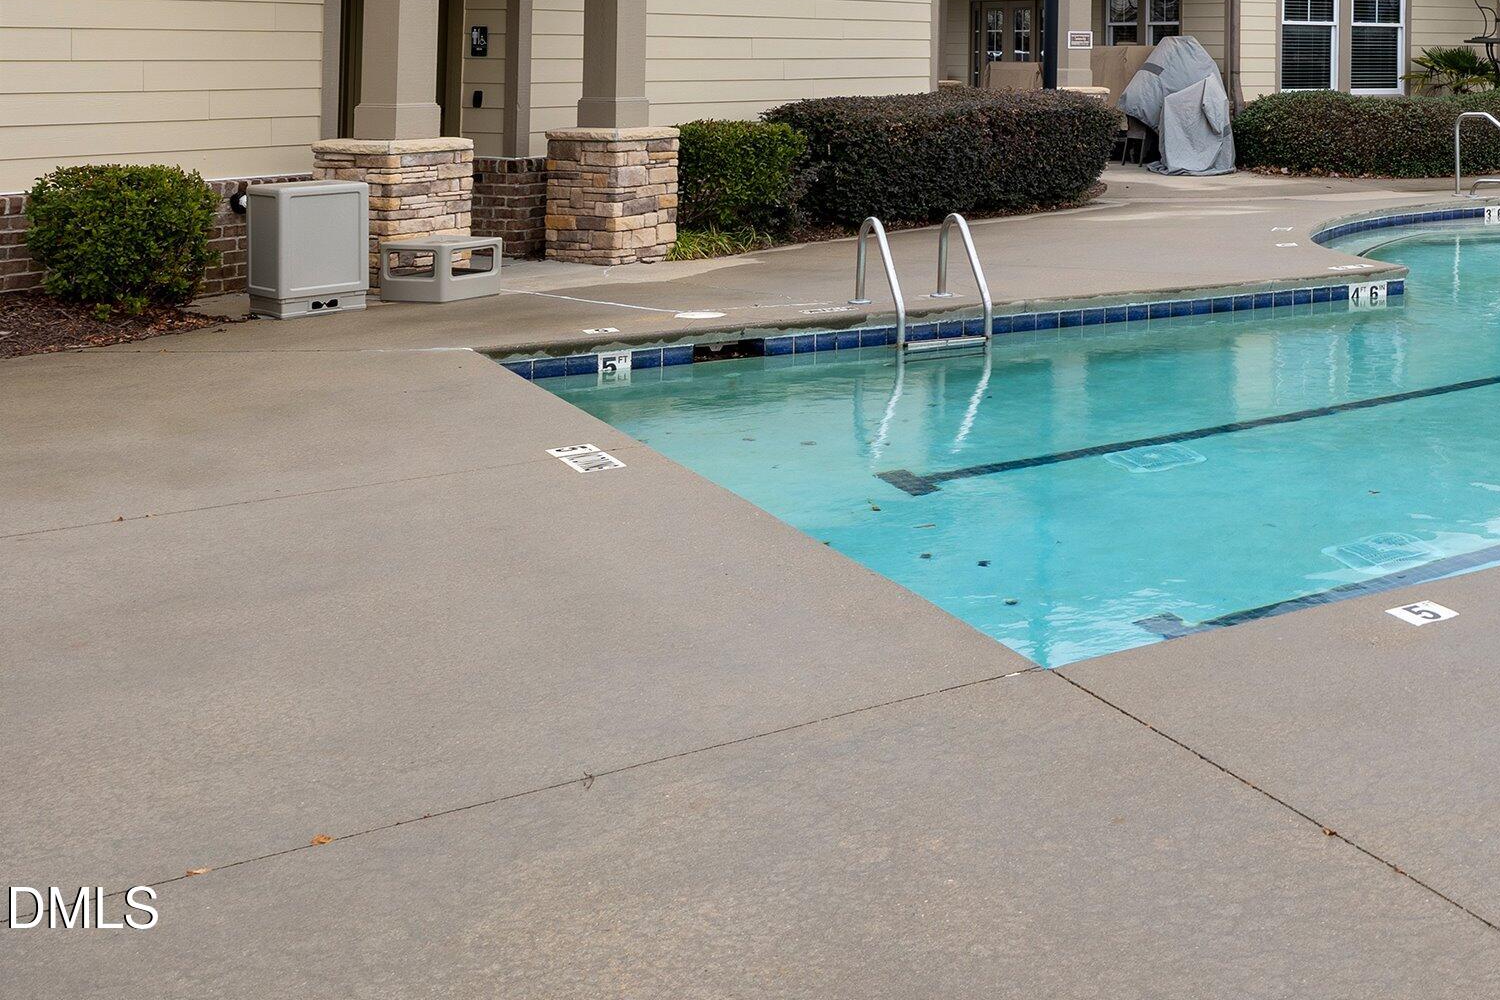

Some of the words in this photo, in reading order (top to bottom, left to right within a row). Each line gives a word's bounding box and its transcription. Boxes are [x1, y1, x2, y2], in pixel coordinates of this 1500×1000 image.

[1351, 287, 1359, 299] 4
[1370, 285, 1379, 300] 6
[602, 356, 617, 371] 5
[618, 355, 629, 363] FT
[1402, 605, 1442, 619] 5
